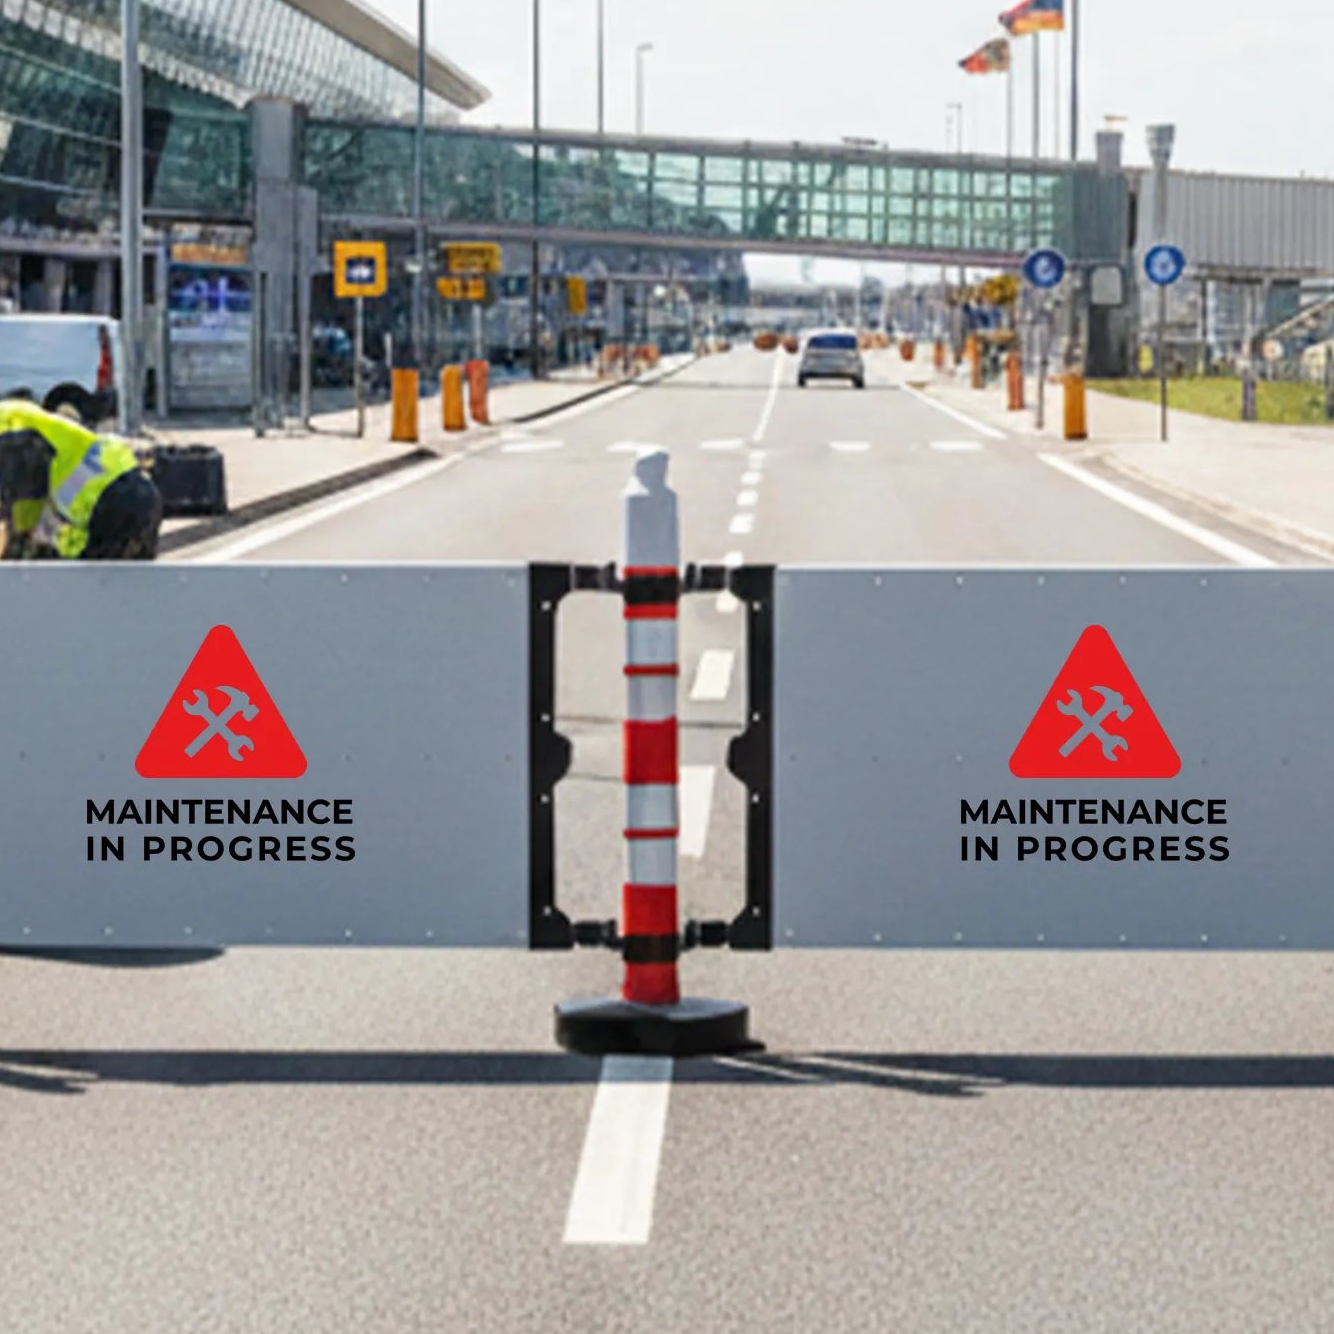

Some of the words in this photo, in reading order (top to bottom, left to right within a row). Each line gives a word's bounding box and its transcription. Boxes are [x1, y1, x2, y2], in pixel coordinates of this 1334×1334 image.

[86, 798, 354, 825] MAINTENANCE
[960, 798, 1228, 825] MAINTENANCE
[86, 835, 125, 862] IN
[143, 835, 356, 862] PROGRESS
[960, 835, 999, 862] IN
[1017, 835, 1230, 862] PROGRESS
